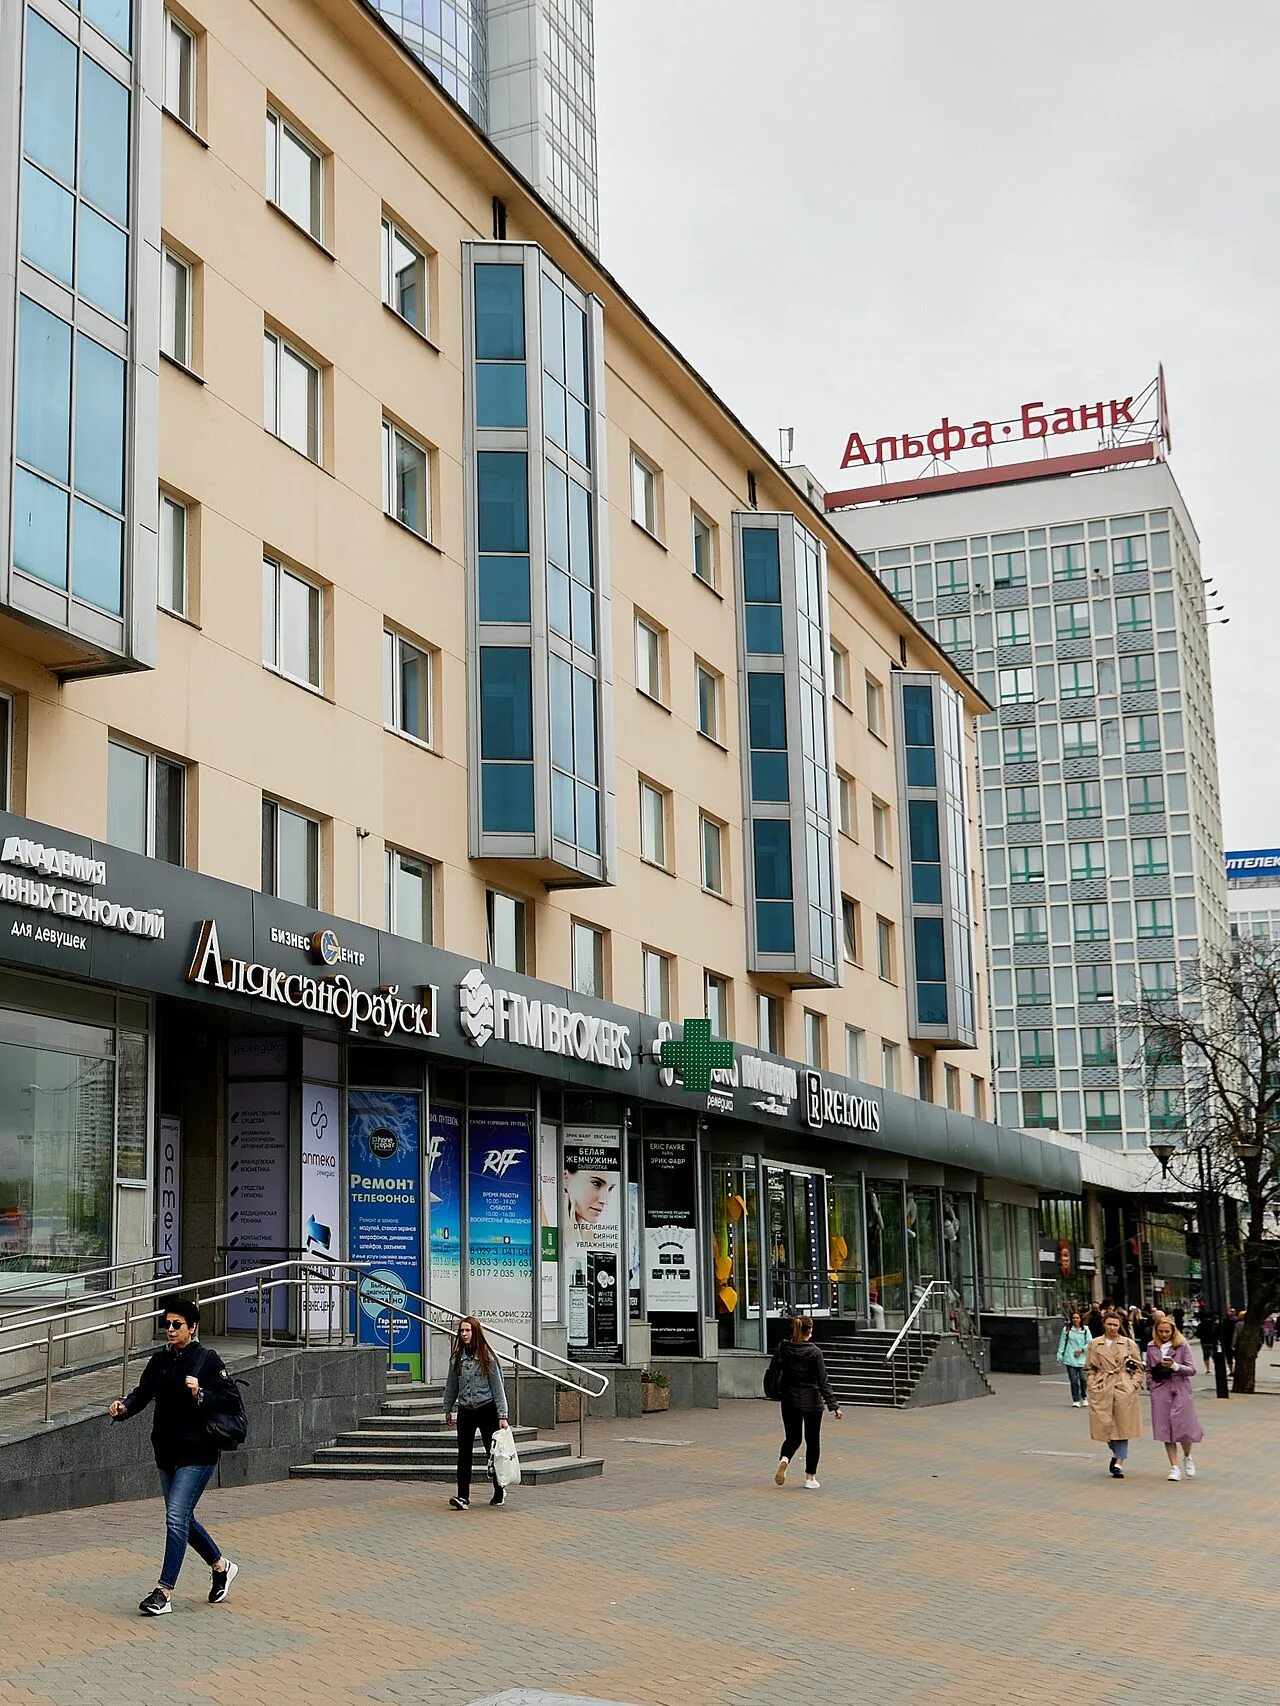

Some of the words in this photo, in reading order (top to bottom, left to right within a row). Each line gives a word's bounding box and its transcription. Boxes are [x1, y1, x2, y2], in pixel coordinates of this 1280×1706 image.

[0, 836, 107, 886] АКАДЕМИЯ
[56, 888, 166, 940] ТЕХНОЛОГИЙ
[11, 921, 33, 940] для
[35, 925, 87, 950] девушек
[271, 927, 311, 951] БИЗНЕС
[494, 988, 543, 1049] FTM
[542, 1003, 633, 1071] BROKERS
[823, 1087, 880, 1133] RELOUIS
[578, 1147, 605, 1156] БЕЛАЯ
[566, 1155, 618, 1165] ЖЕМЧУЖИНА
[351, 1174, 415, 1190] Ремонт
[352, 1193, 416, 1204] ТЕЛЕФОНОВ
[573, 1223, 619, 1231] ОТБЕЛИВАНИЕ
[477, 1258, 491, 1266] 033
[502, 1259, 516, 1267] 631
[477, 1269, 491, 1277] 017
[498, 1310, 519, 1318] ОФИС
